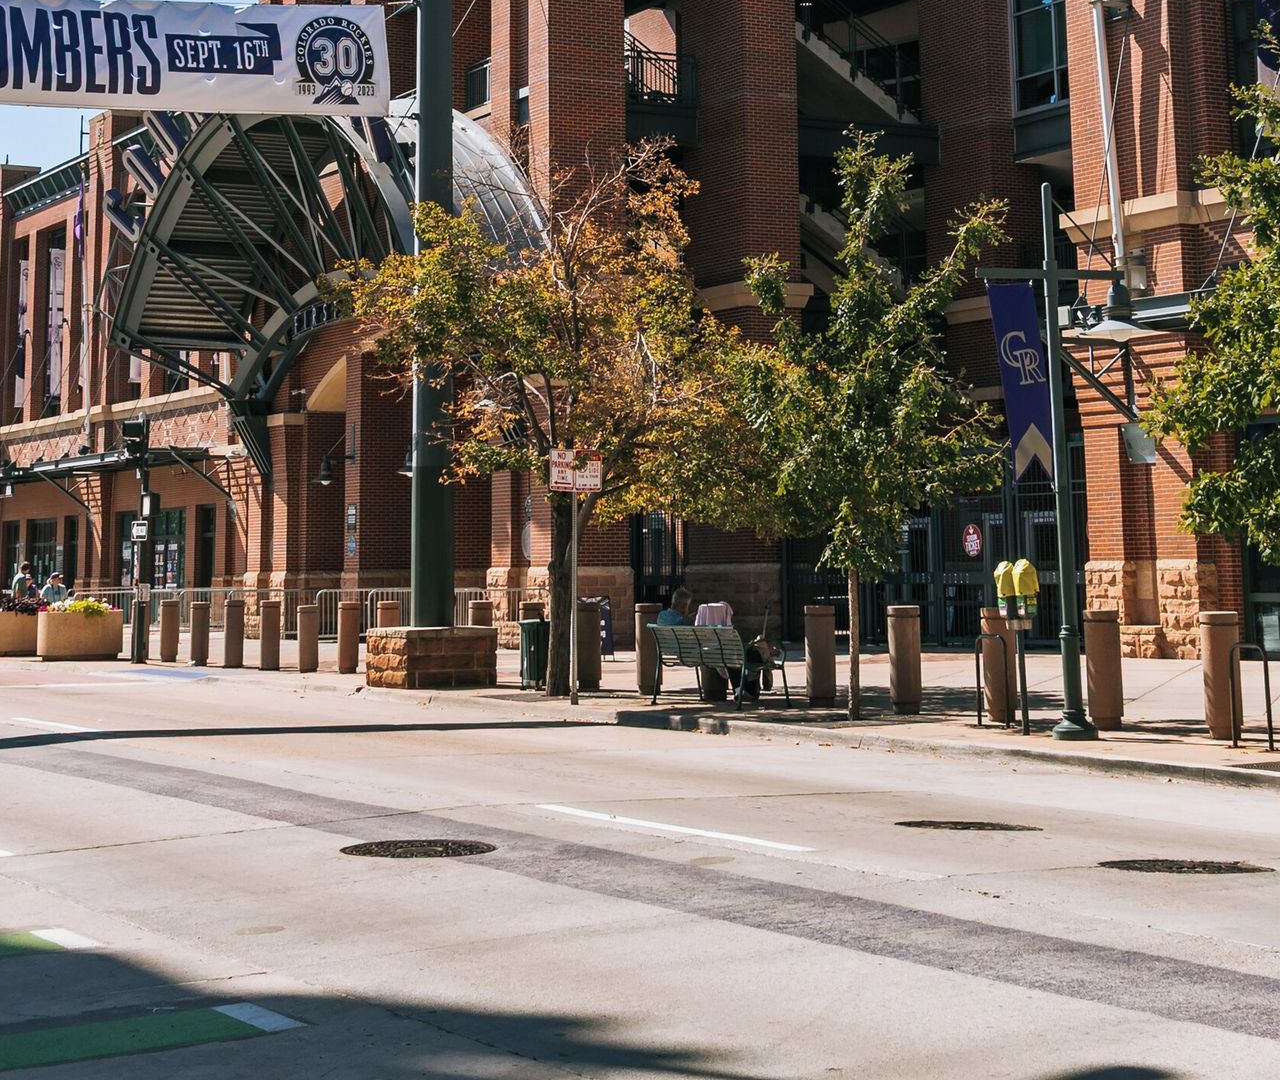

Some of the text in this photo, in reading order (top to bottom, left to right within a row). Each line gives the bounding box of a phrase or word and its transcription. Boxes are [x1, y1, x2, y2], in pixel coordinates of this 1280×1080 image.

[173, 38, 269, 70] SEPT. 16TH
[296, 17, 374, 66] COLORADO ROCKIES
[312, 36, 360, 78] 30
[298, 84, 316, 95] 1993
[357, 85, 375, 96] 2023
[1000, 330, 1047, 385] CR
[557, 452, 567, 460] NO
